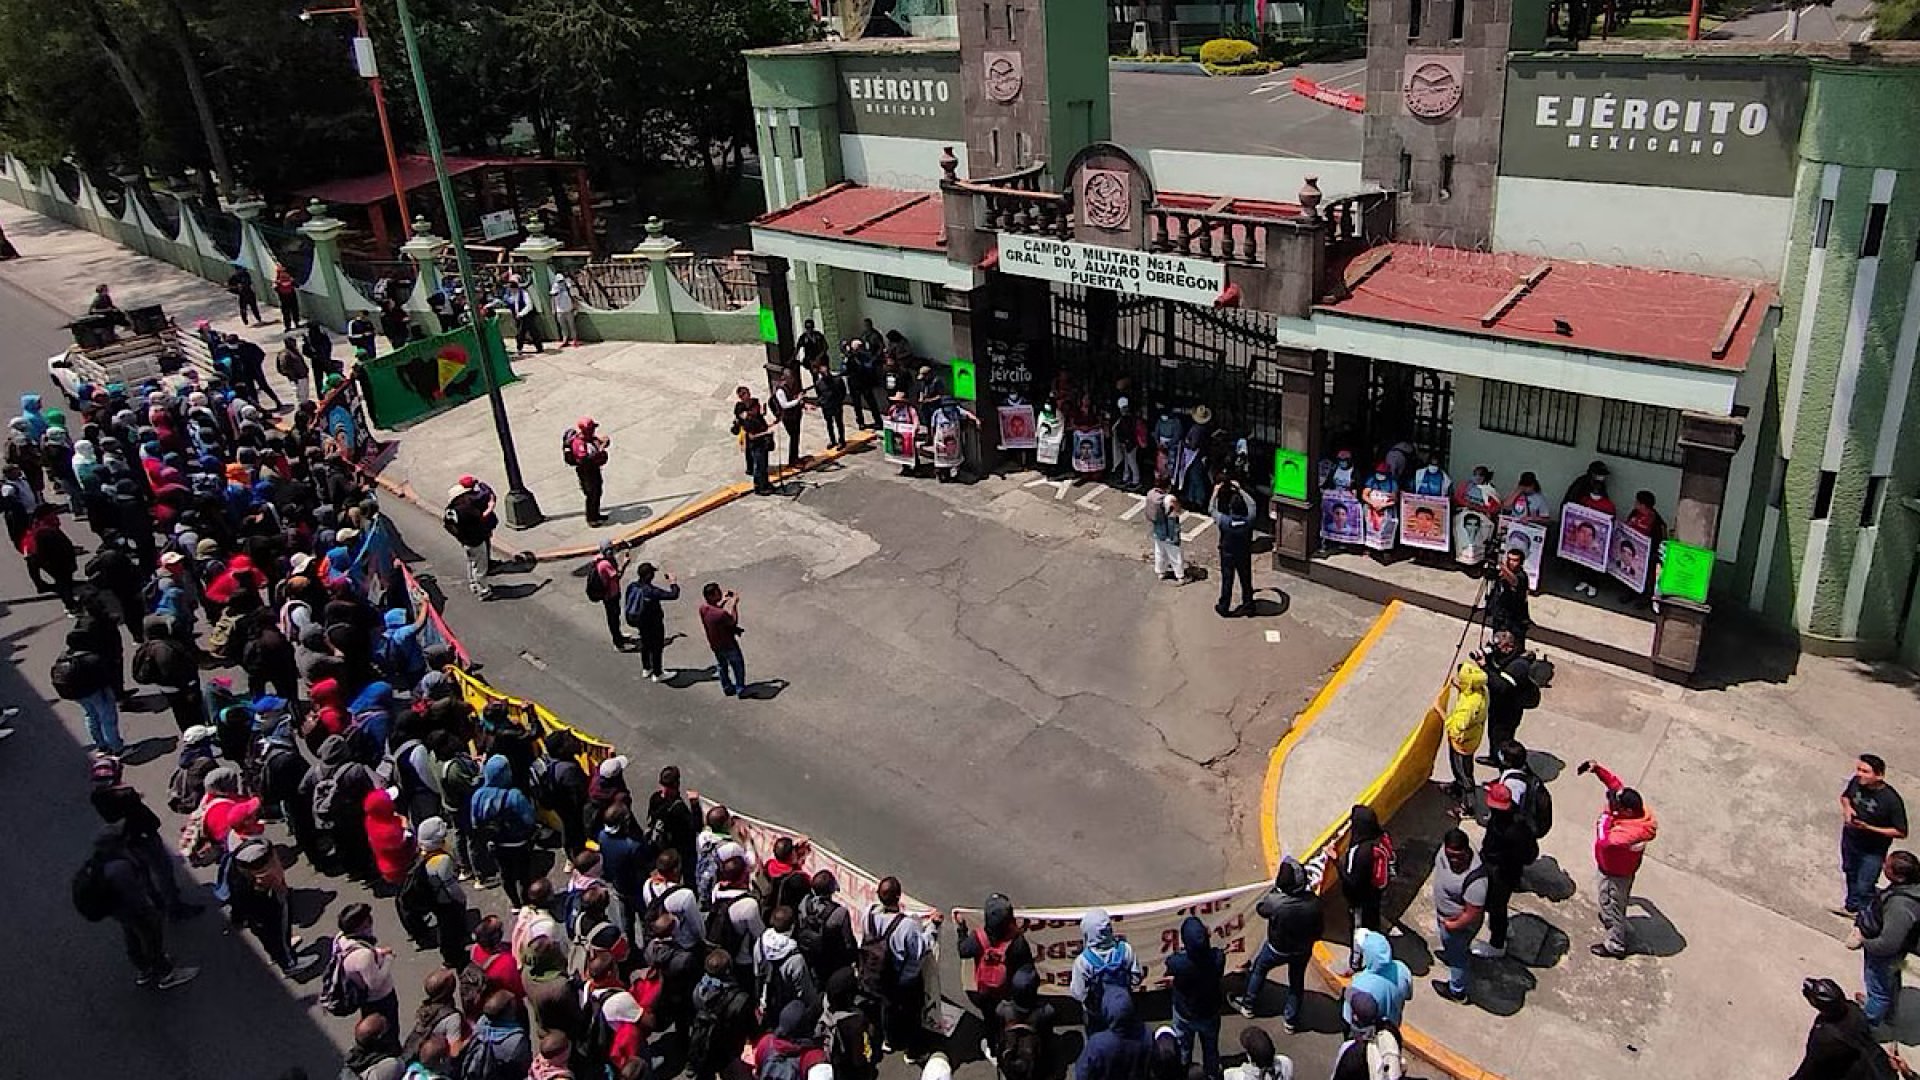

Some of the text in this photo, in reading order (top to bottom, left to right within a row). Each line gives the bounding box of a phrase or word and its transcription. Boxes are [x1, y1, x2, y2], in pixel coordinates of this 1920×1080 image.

[849, 74, 949, 102] EJÉRCITO
[1535, 93, 1768, 136] EJÉRCITO
[1567, 134, 1724, 156] MEXICANO
[1006, 249, 1044, 265] GRAL.
[1054, 256, 1078, 270] DIV.
[1084, 261, 1140, 279] ALVARO
[1023, 240, 1071, 257] CAMPO
[1082, 248, 1140, 267] MILITAR
[1071, 271, 1140, 292] PUERTA 1
[989, 363, 1033, 383] jército
